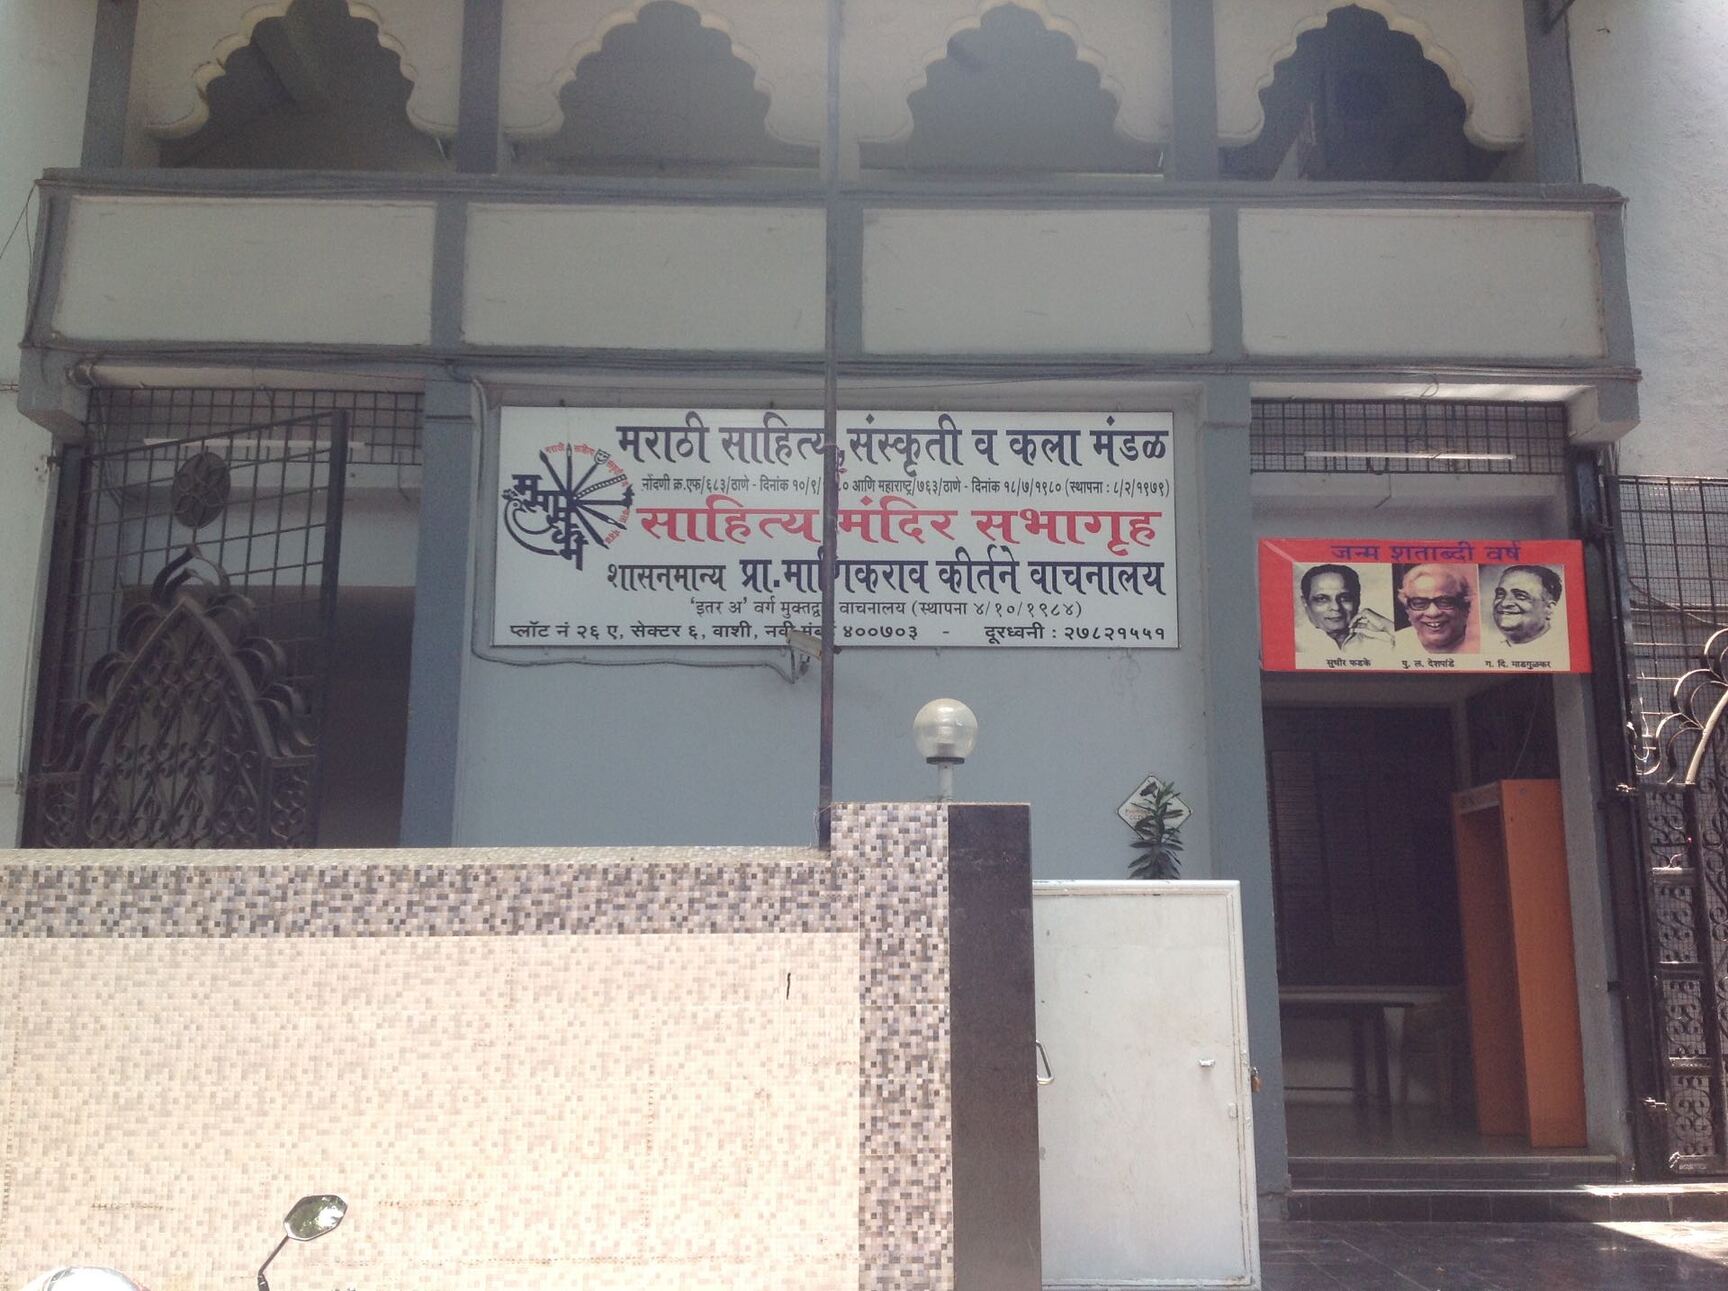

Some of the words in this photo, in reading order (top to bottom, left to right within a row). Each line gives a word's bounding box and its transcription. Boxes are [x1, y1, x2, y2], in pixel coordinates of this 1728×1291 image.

[616, 411, 710, 464] मराठी
[719, 412, 846, 467] साहित्य
[846, 413, 964, 477] संस्कृती
[971, 428, 998, 467] व
[1006, 428, 1083, 467] कला
[1089, 415, 1170, 468] मंडळ
[642, 474, 671, 492] नोंदणी
[760, 475, 789, 492] दिनांक
[852, 477, 875, 492] आणि
[971, 477, 1000, 493] दिनांक
[636, 494, 821, 545] साहित्य
[838, 495, 957, 544] मंदिर
[972, 508, 1163, 555] सभागृह
[1331, 545, 1380, 561] जन्म
[1390, 541, 1475, 562] शताब्दी
[1484, 541, 1522, 561] वर्ष
[607, 563, 727, 592] शासनमान्य
[936, 544, 1021, 594] कीर्तने
[1028, 561, 1166, 596] वाचनालय
[753, 596, 775, 614] वर्ग
[838, 602, 907, 615] वाचनालय
[912, 600, 968, 617] (स्थापना
[510, 620, 549, 639] प्लॉट
[556, 620, 570, 639] नं
[577, 624, 599, 640] २६
[631, 621, 682, 639] सेक्टर
[689, 624, 705, 640] ६,
[713, 620, 757, 640] वाशी,
[843, 624, 918, 640] ४००७०३
[985, 621, 1045, 643] दूरध्वनी
[1063, 626, 1166, 641] २७८२१५५१
